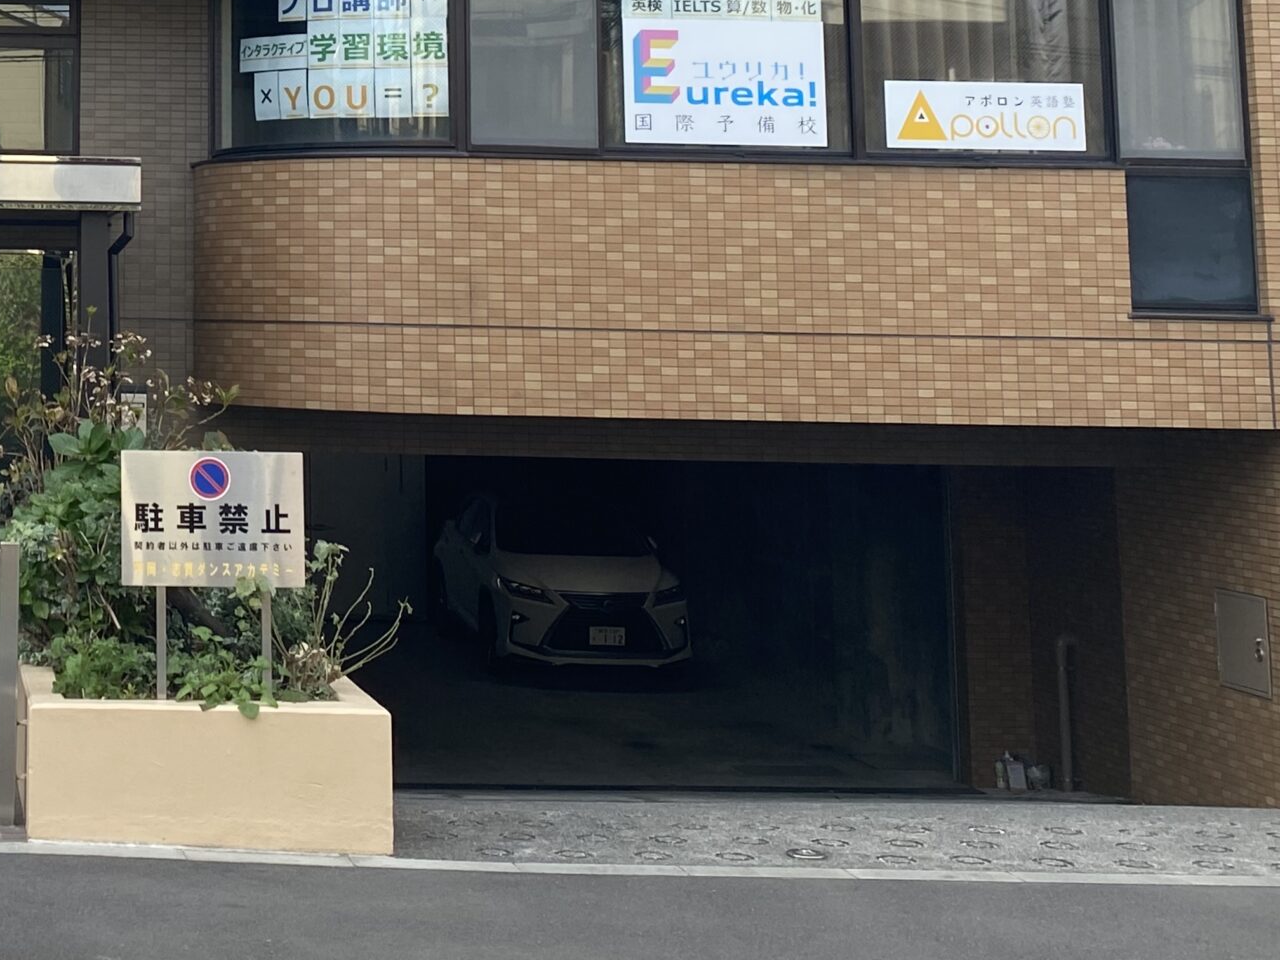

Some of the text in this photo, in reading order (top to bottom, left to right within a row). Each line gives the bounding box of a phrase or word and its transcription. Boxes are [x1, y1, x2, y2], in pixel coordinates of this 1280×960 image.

[673, 0, 721, 13] IELTS
[309, 31, 446, 62] 学習環境
[634, 113, 818, 135] 国際予備校
[134, 502, 291, 534] 駐車禁止
